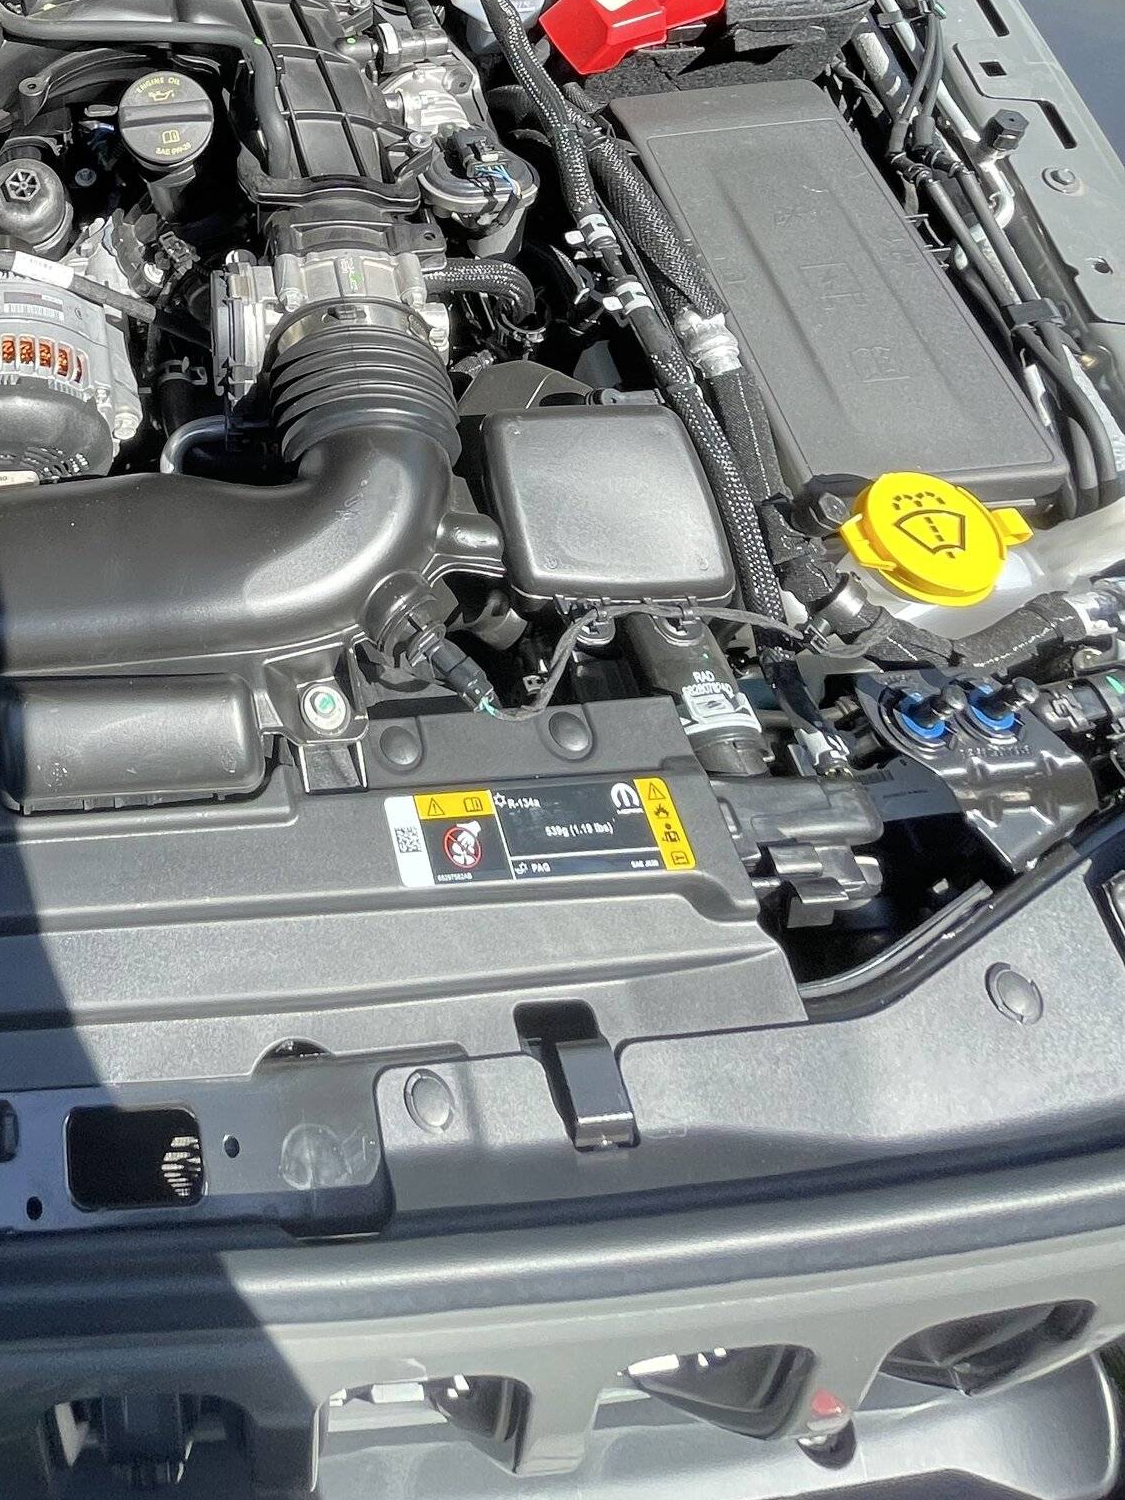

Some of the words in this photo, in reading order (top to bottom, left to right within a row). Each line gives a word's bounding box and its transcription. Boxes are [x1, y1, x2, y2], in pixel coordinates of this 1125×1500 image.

[135, 77, 165, 93] ENGINE
[168, 77, 180, 86] OIL
[692, 670, 716, 683] RAD
[507, 797, 541, 809] R-134a
